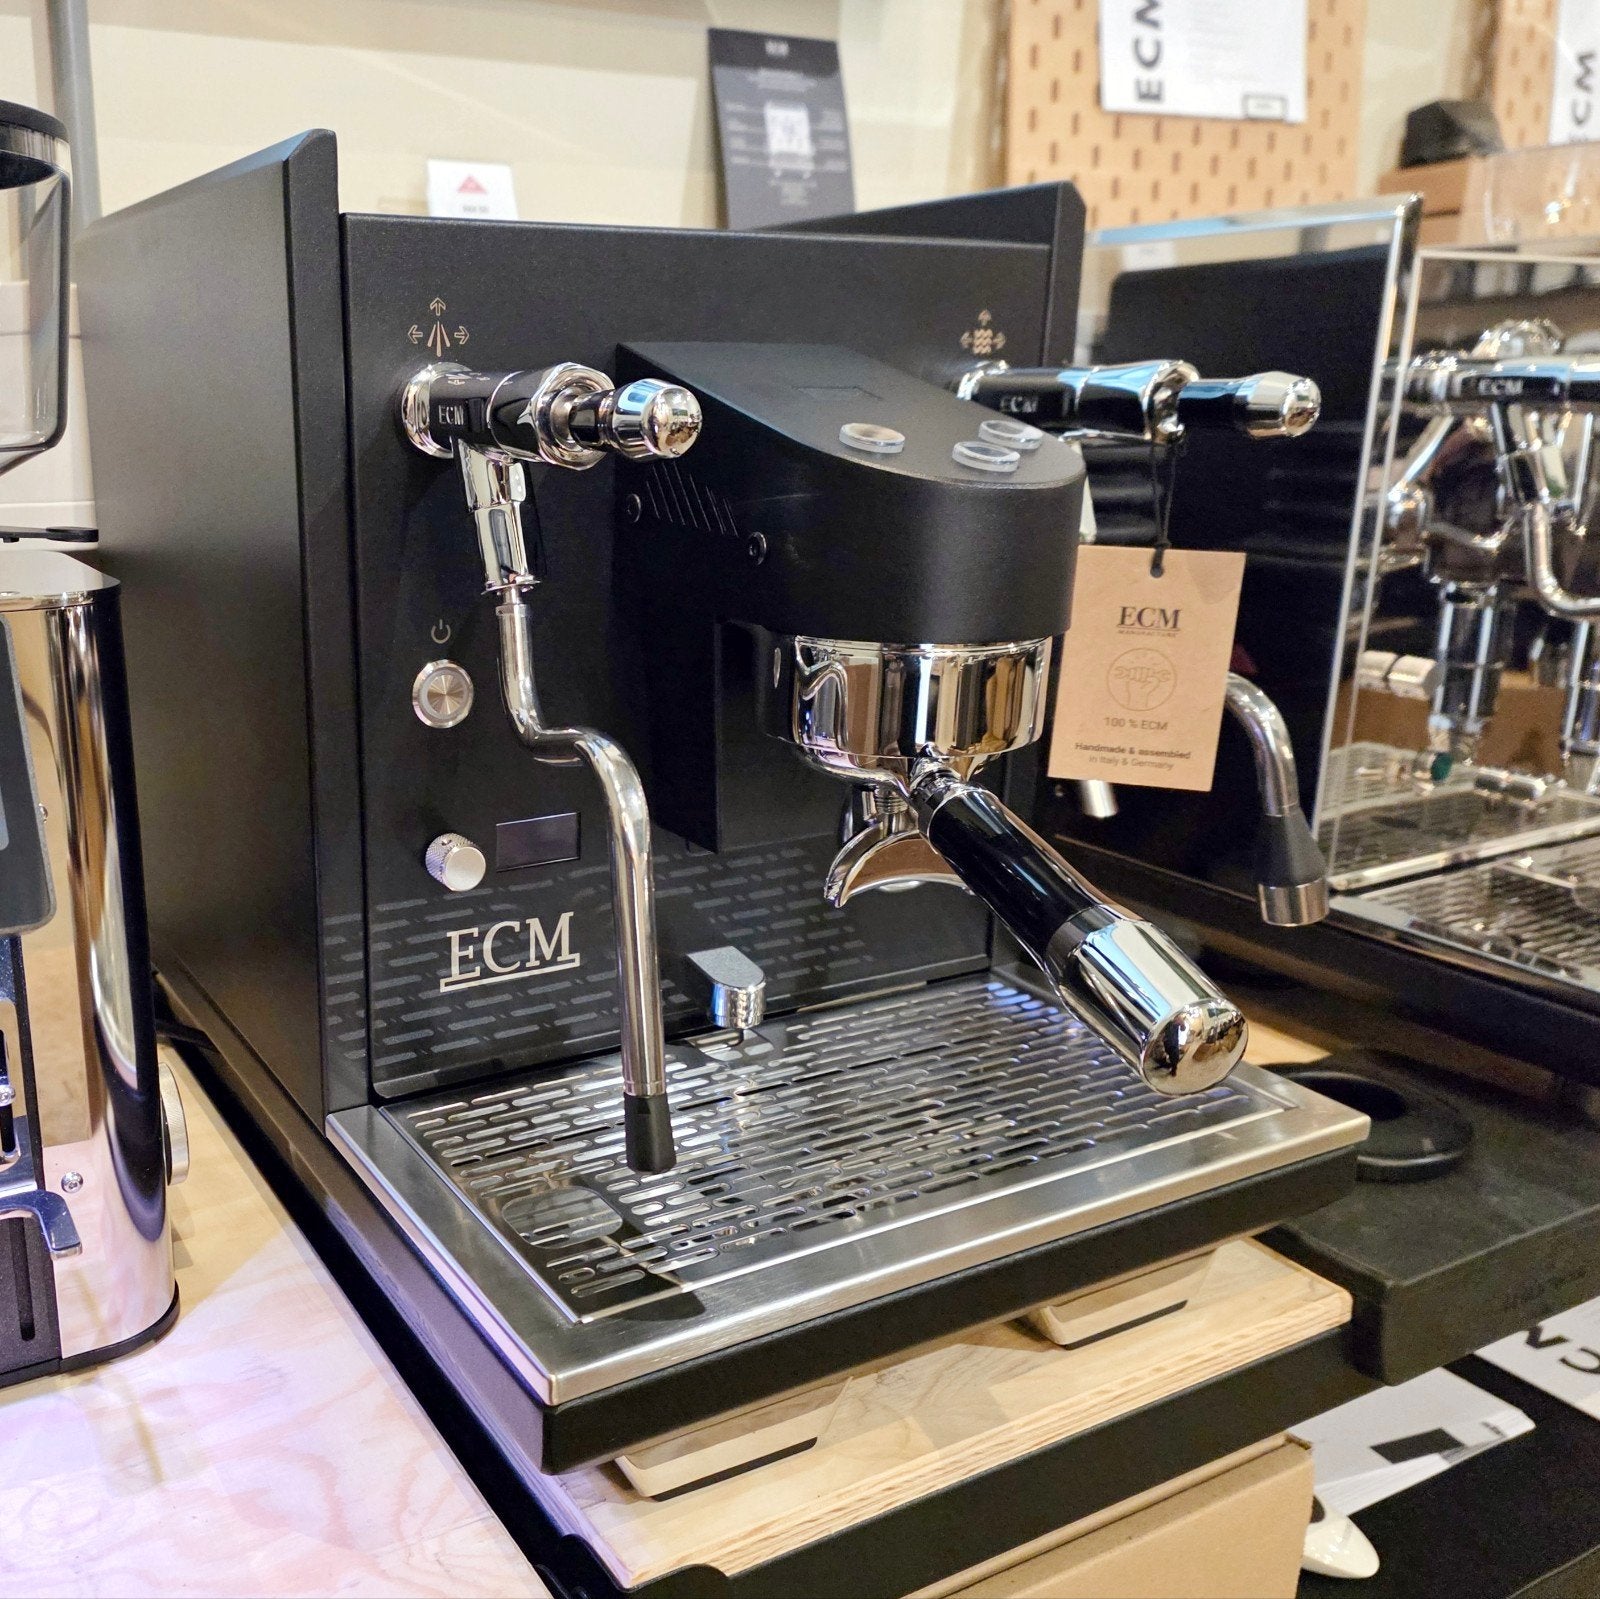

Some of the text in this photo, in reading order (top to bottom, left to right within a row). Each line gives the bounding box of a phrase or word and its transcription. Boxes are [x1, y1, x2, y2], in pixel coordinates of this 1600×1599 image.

[1478, 378, 1524, 396] ECM
[438, 404, 464, 426] ECM
[1117, 605, 1182, 630] ECM
[1103, 717, 1126, 728] 100
[1141, 719, 1169, 731] ECM
[1074, 743, 1126, 754] Handmade
[1138, 748, 1192, 760] assembled
[1131, 758, 1175, 771] Germany
[440, 911, 580, 992] ECM
